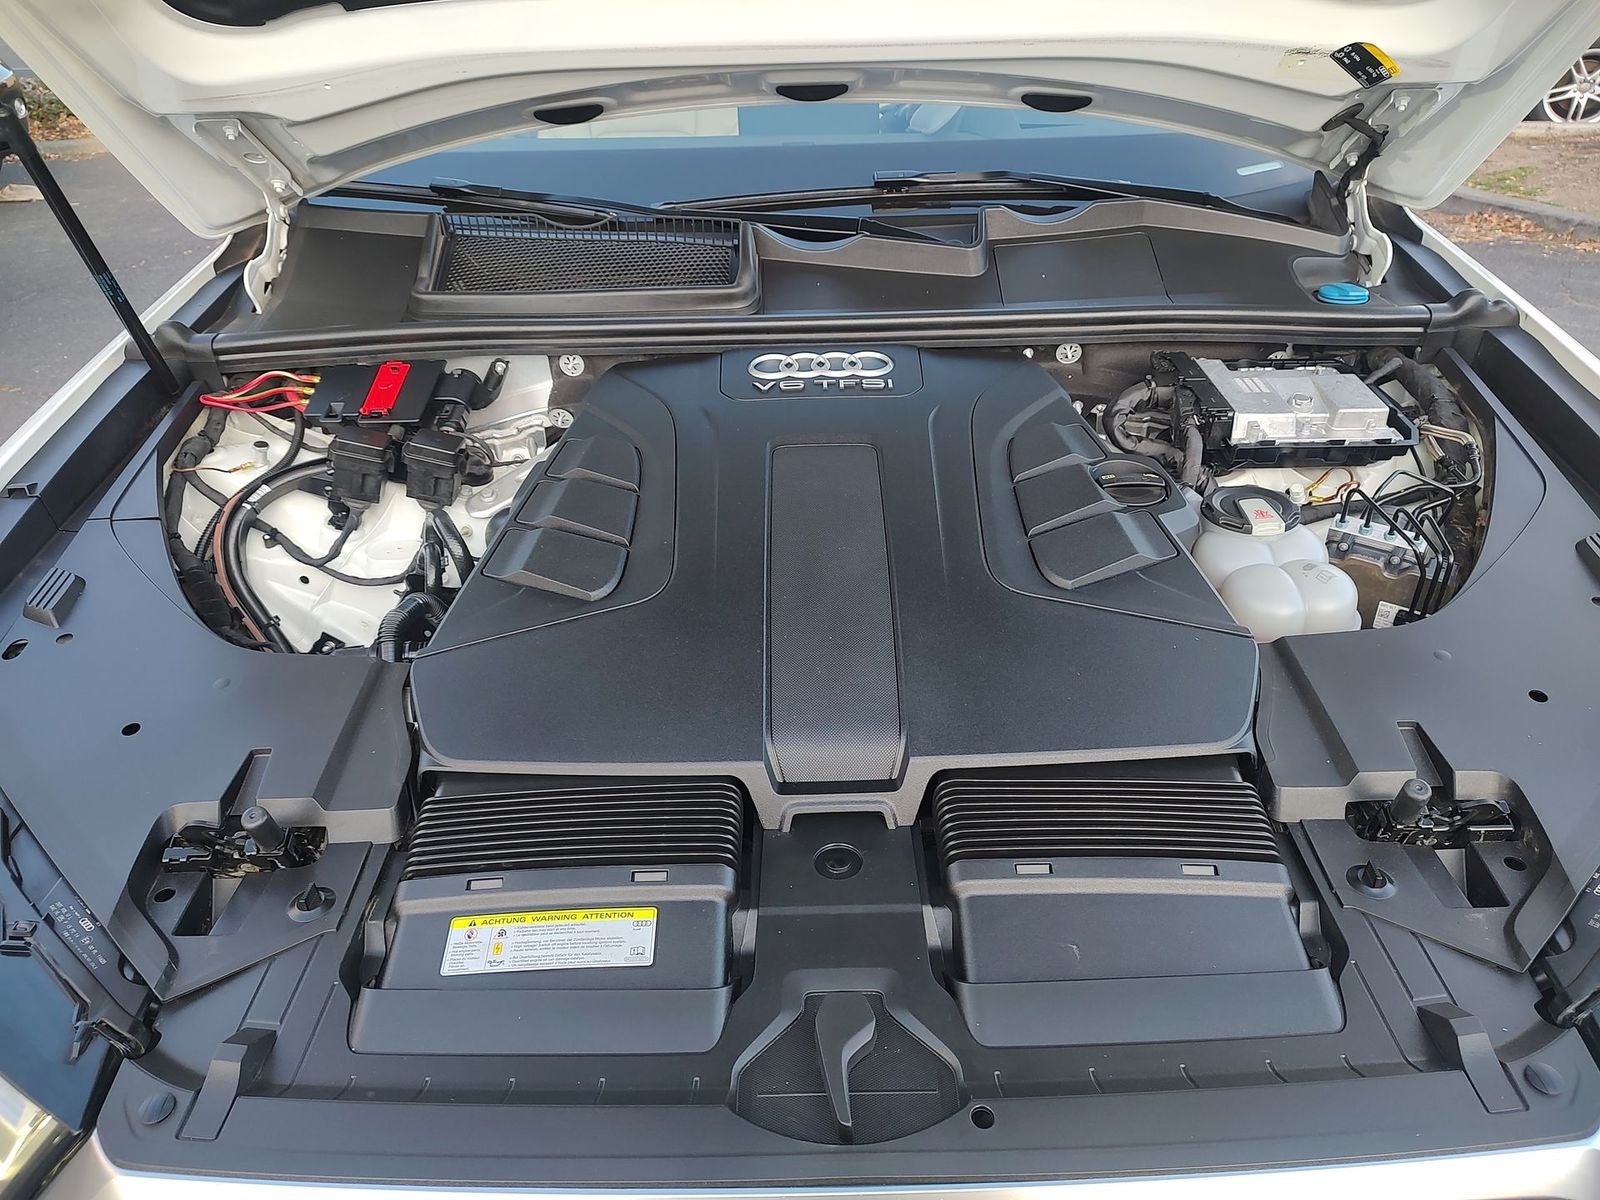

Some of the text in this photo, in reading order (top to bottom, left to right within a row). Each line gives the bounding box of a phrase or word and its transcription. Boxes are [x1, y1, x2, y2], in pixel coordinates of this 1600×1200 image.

[752, 378, 894, 392] V6 TFSI
[481, 916, 526, 926] ACHTUNG
[531, 913, 578, 923] WARNING
[582, 911, 634, 920] ATTENTION
